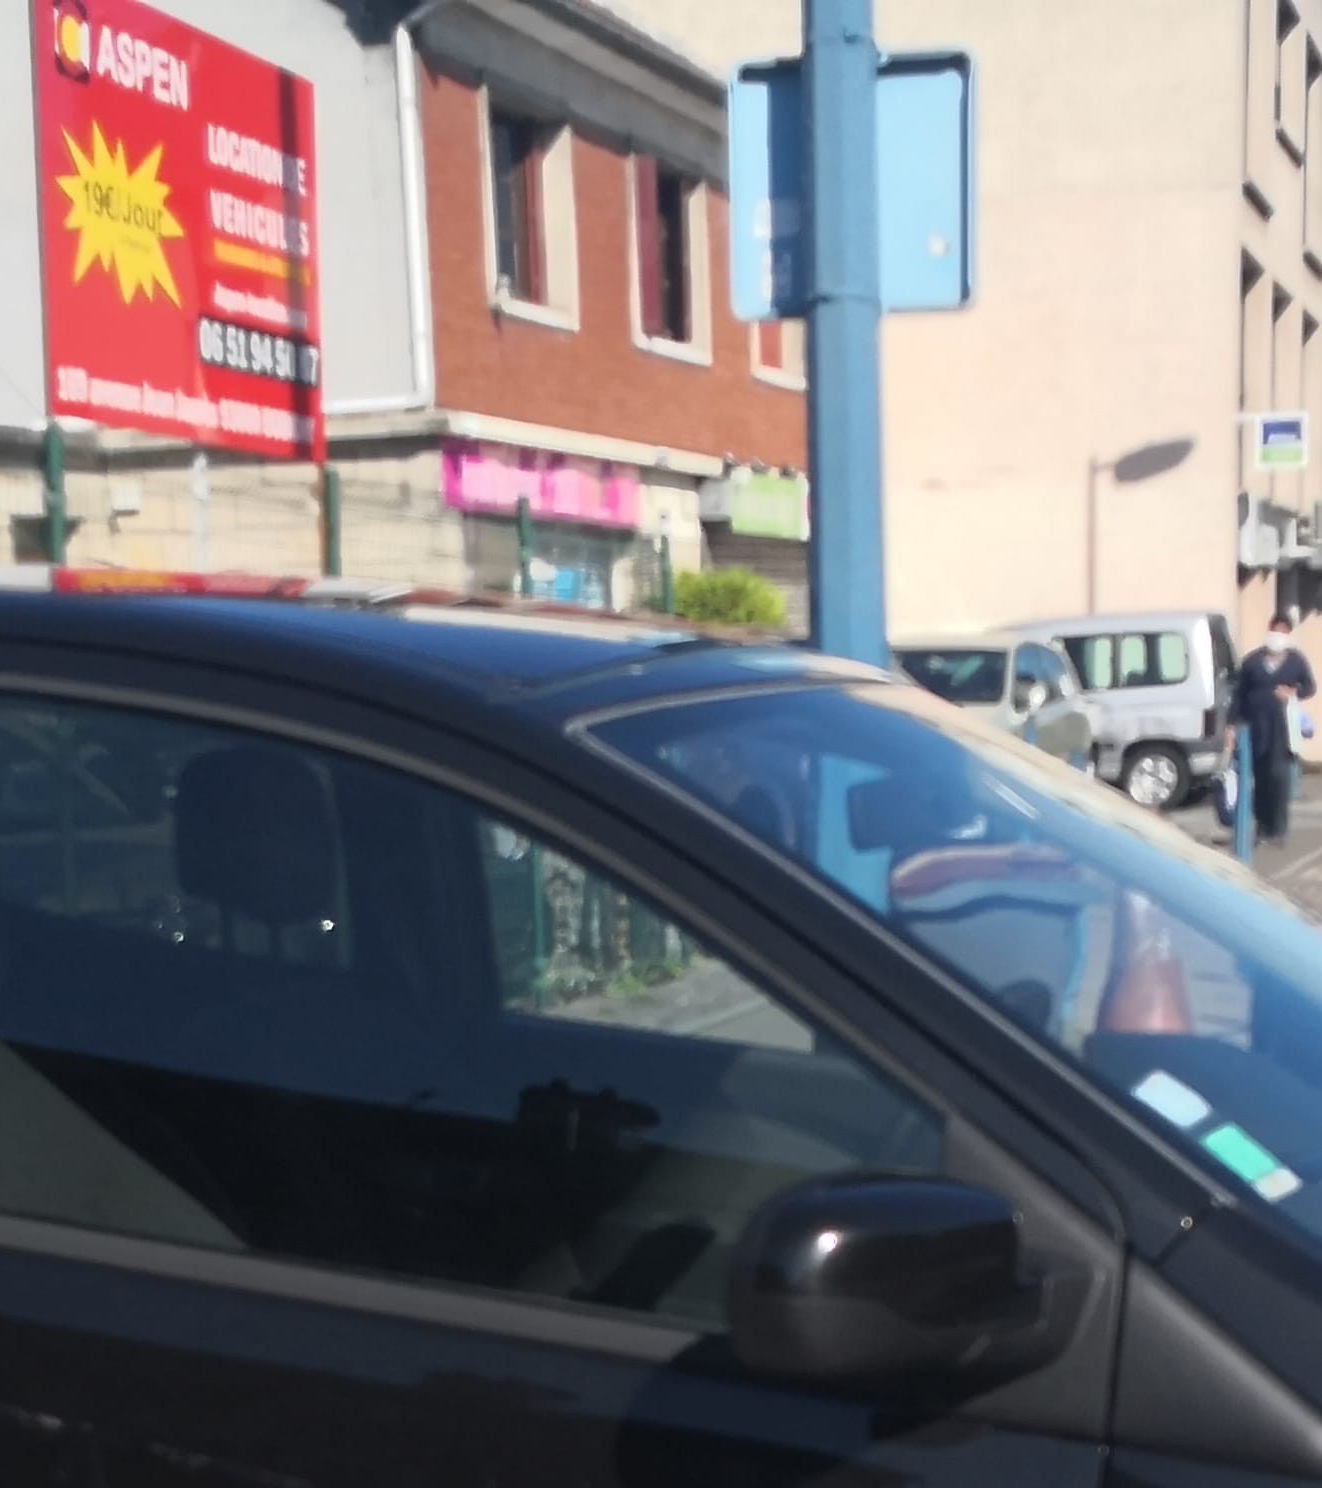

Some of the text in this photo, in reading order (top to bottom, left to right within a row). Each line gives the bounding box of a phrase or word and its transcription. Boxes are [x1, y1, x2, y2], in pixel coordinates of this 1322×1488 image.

[97, 23, 188, 111] ASPEN
[207, 122, 283, 188] LOCATION
[200, 316, 224, 362] 06
[226, 325, 248, 369] 51
[297, 343, 319, 387] 7
